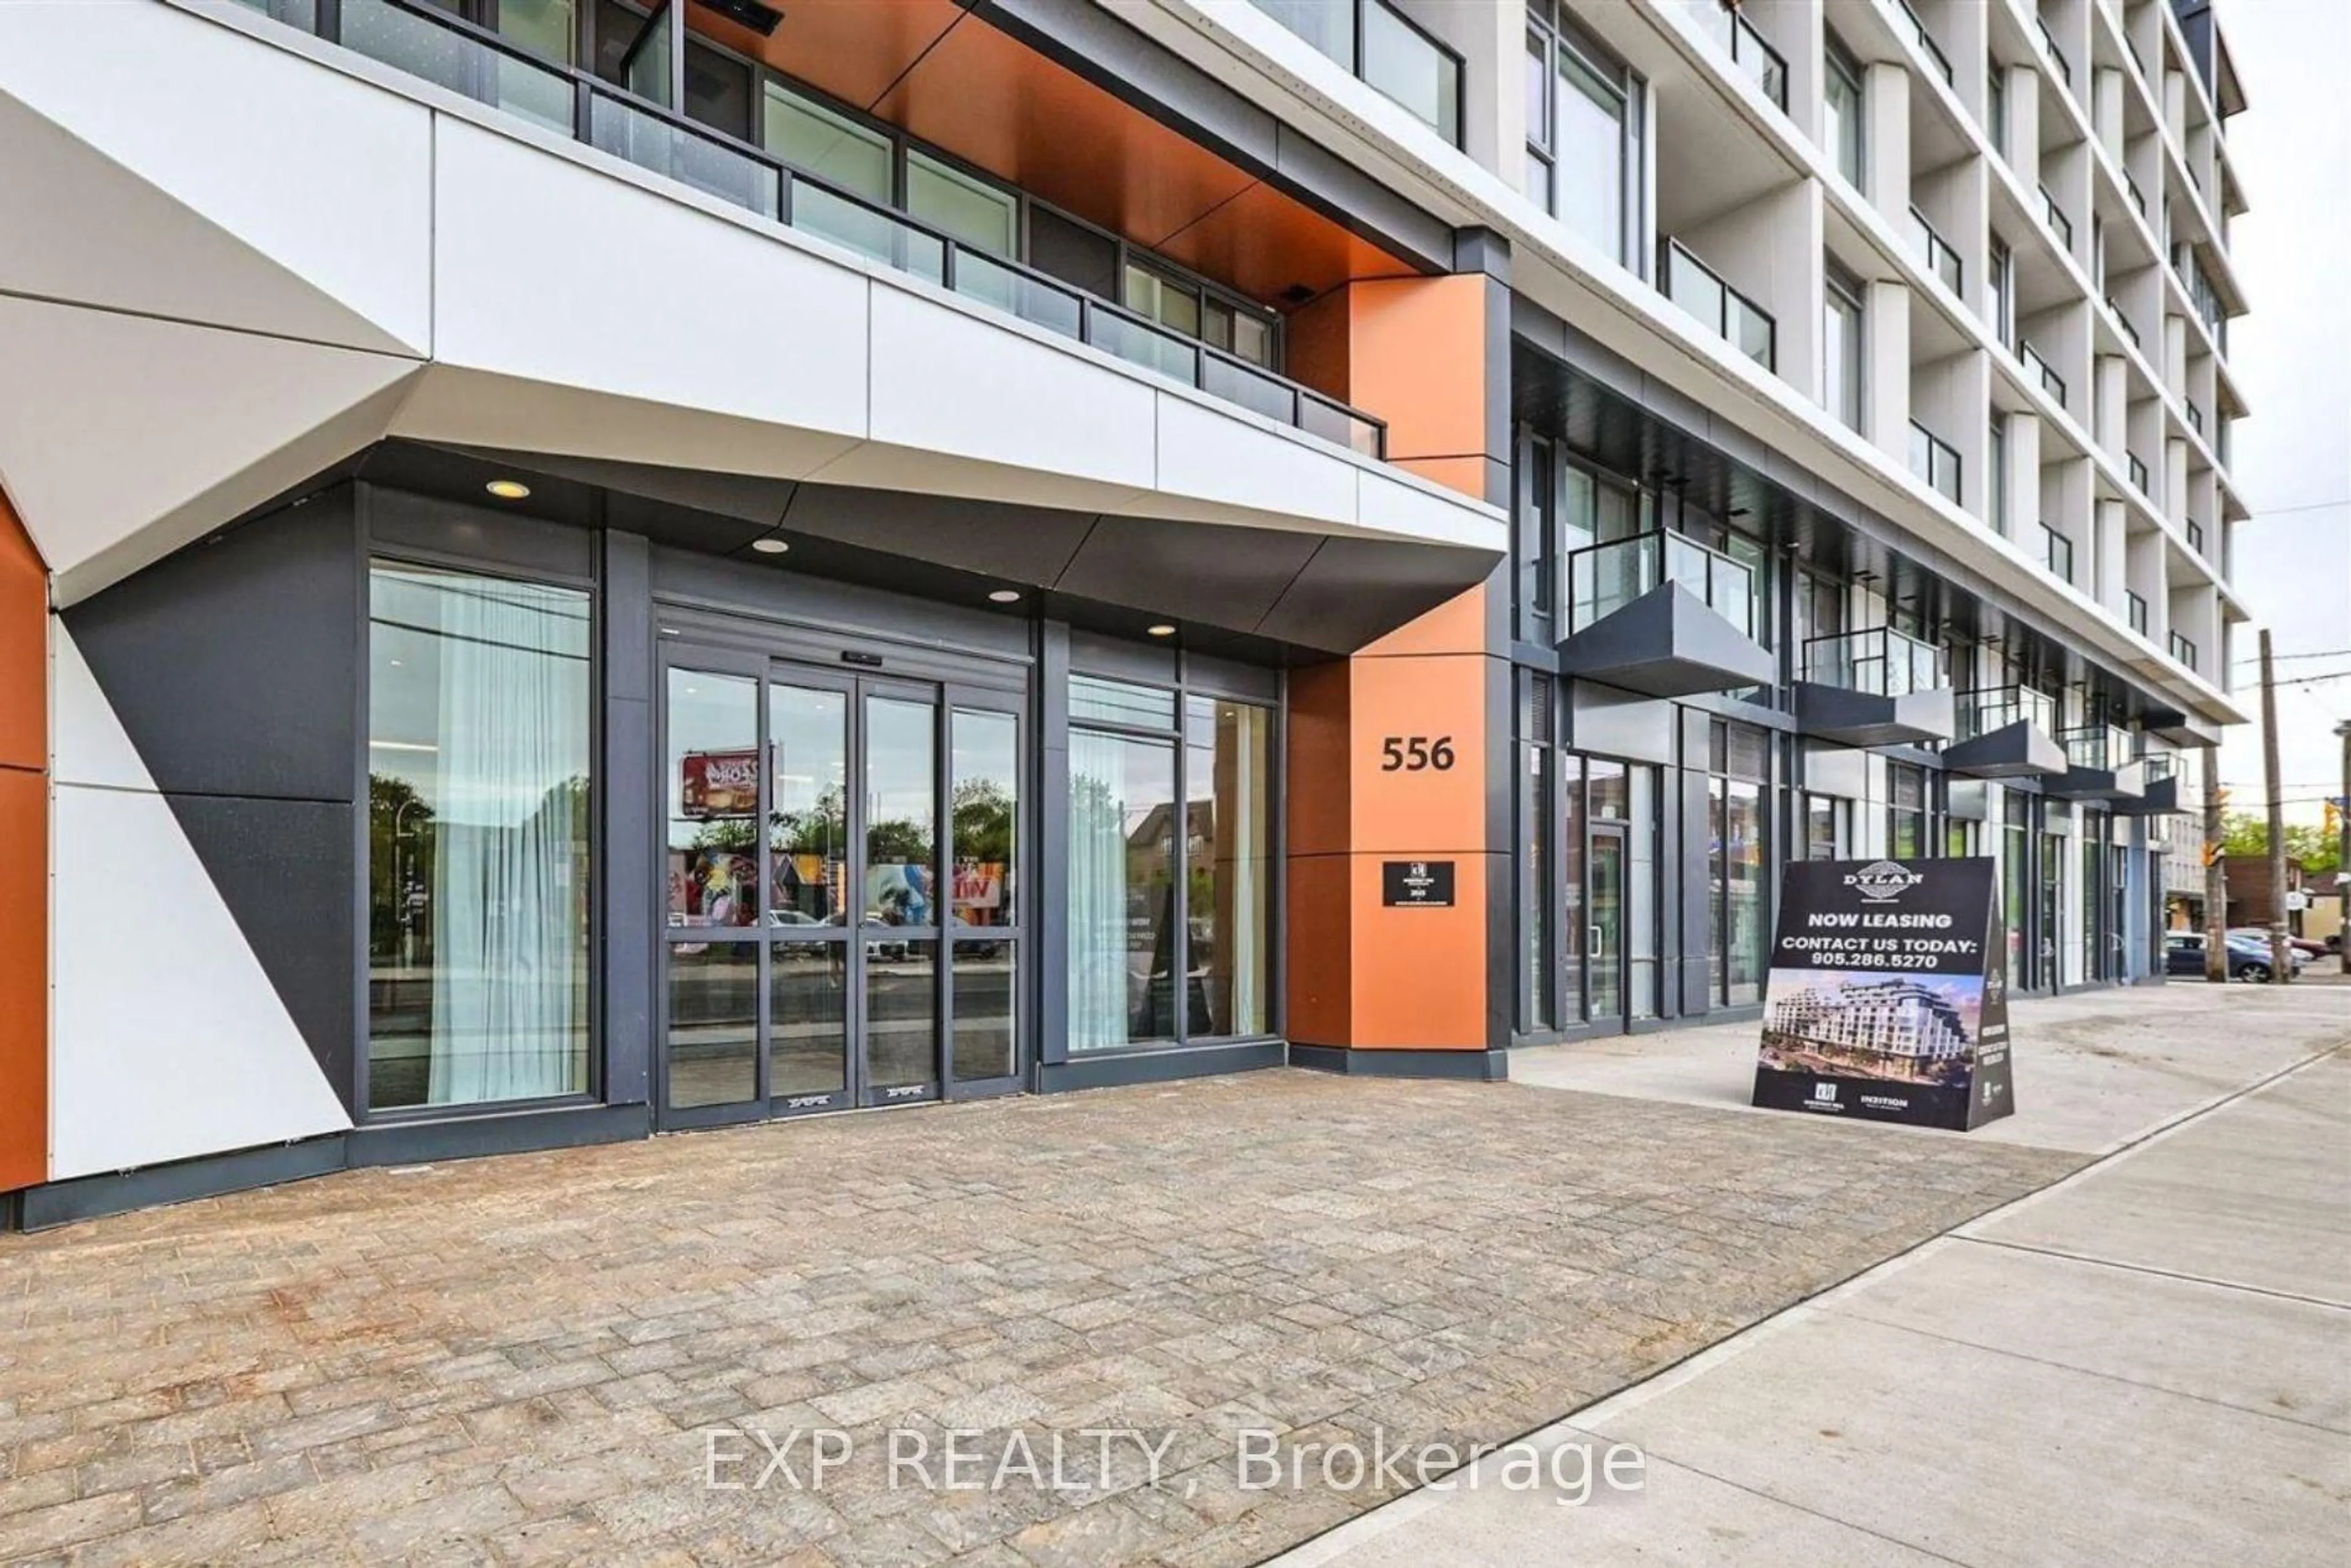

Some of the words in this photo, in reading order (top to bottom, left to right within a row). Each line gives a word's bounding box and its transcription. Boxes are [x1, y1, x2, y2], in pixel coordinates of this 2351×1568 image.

[1381, 736, 1455, 771] 556
[1843, 874, 1924, 885] DYLAN
[1808, 913, 1859, 927] NOW
[1862, 914, 1952, 928] LEASING
[1782, 937, 1870, 950] CONTACT
[1873, 939, 1898, 951] US
[1903, 939, 1978, 953] TODAY:
[1812, 952, 1938, 968] 905.286.5270
